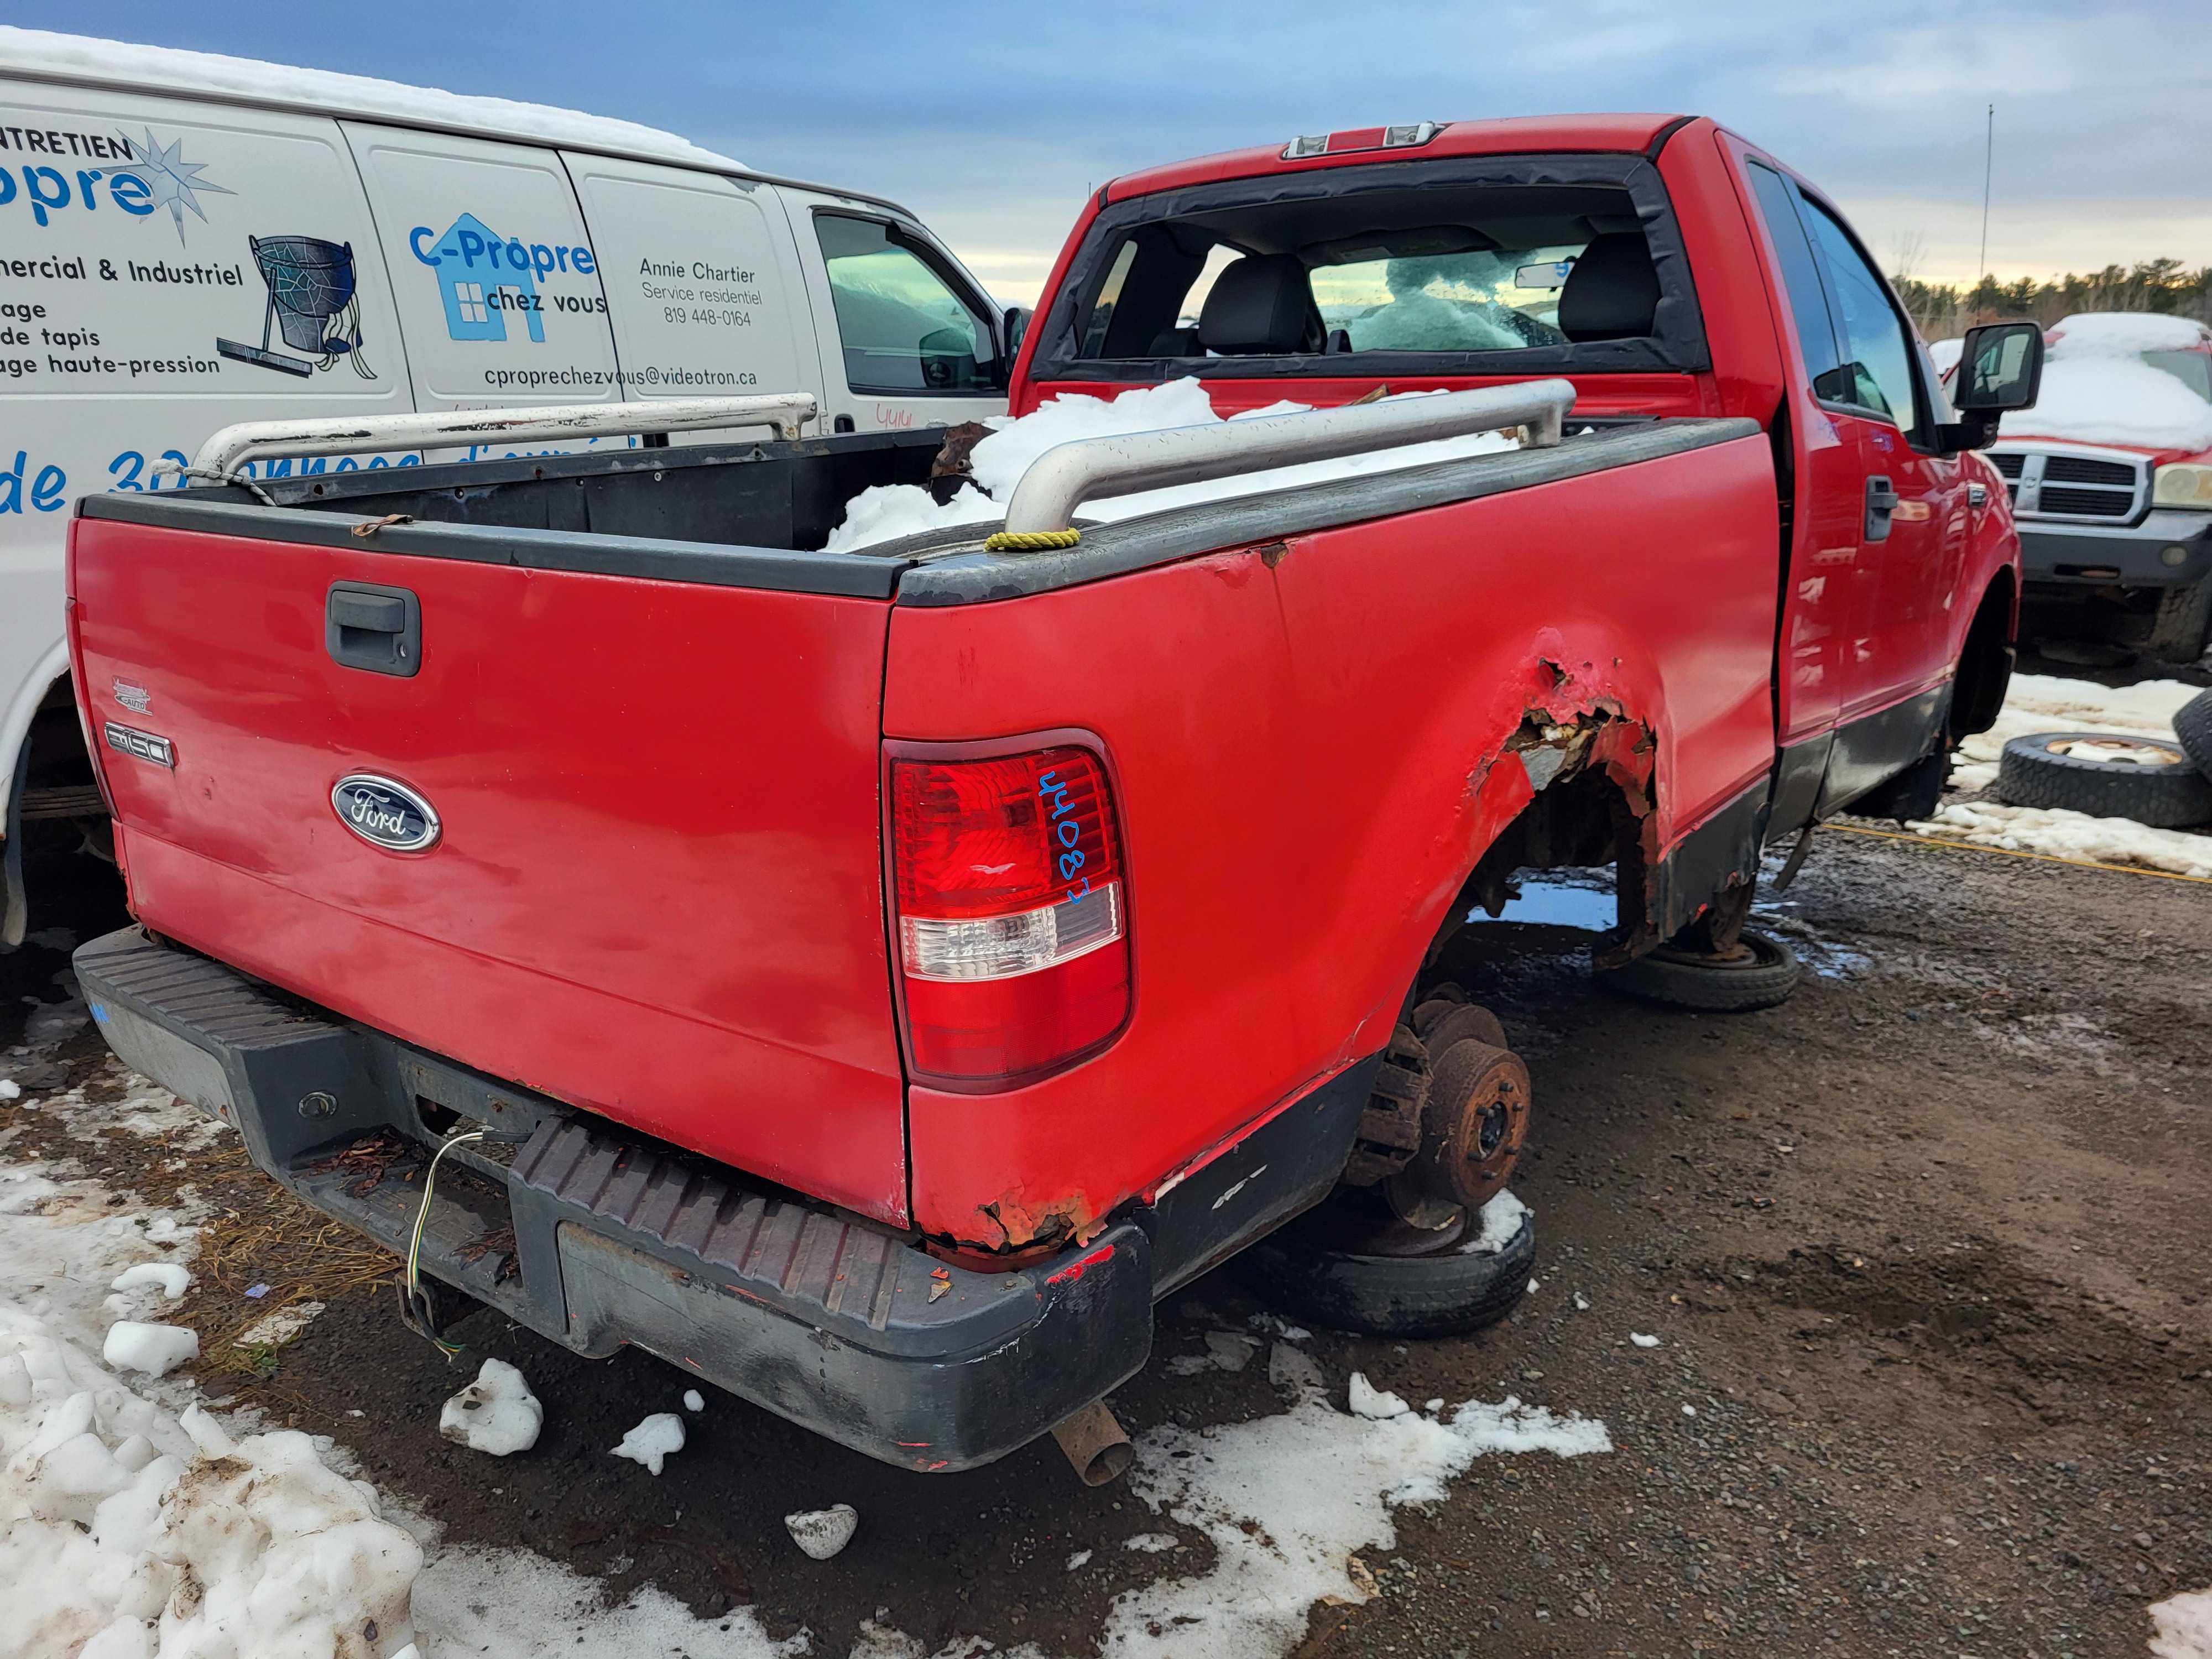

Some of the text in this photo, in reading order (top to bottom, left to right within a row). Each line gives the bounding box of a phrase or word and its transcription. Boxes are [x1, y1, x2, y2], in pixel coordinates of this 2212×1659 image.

[409, 226, 596, 283] C-Propre
[98, 259, 118, 281] &
[128, 260, 243, 286] Industriel
[639, 258, 755, 283] Annie Chartier
[487, 286, 607, 313] chez vous
[641, 281, 763, 305] Service residentiel
[664, 306, 752, 327] 819 448-0164
[0, 326, 100, 351] de tapis
[48, 354, 221, 378] haute-pression
[484, 365, 757, 389] cproprechezvous@videotron.ca
[0, 450, 66, 514] de
[351, 788, 406, 836] Ford
